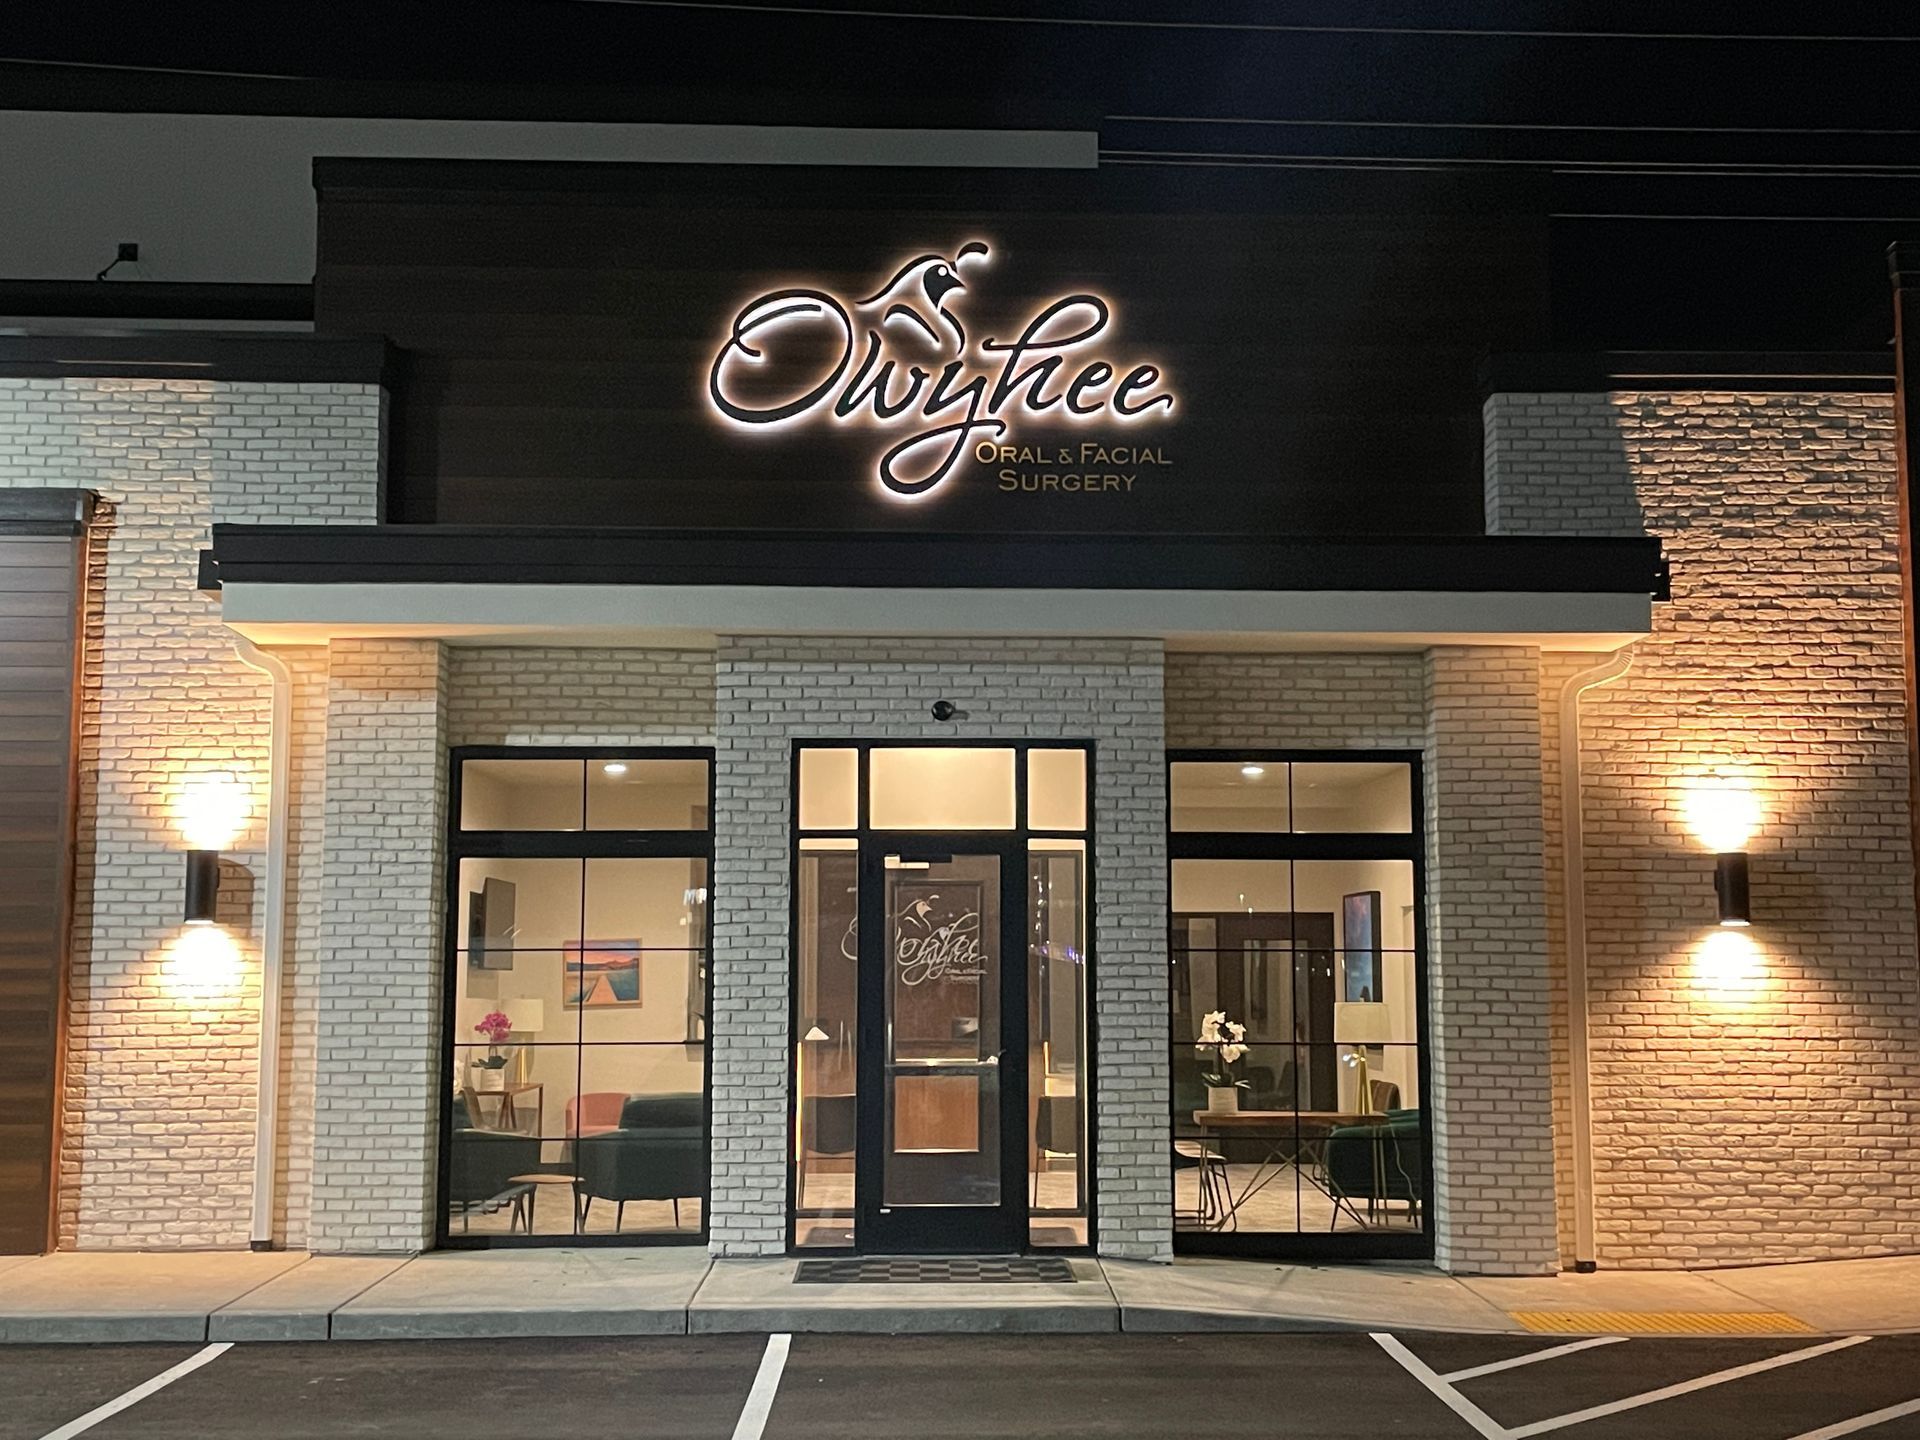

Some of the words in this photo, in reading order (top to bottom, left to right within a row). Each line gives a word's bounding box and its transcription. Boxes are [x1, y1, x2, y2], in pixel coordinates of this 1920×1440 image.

[710, 288, 1174, 495] Owyhee
[976, 441, 1052, 464] ORAL
[1058, 448, 1074, 464] &
[1081, 443, 1173, 464] FACIAL
[999, 469, 1136, 491] SURGERY
